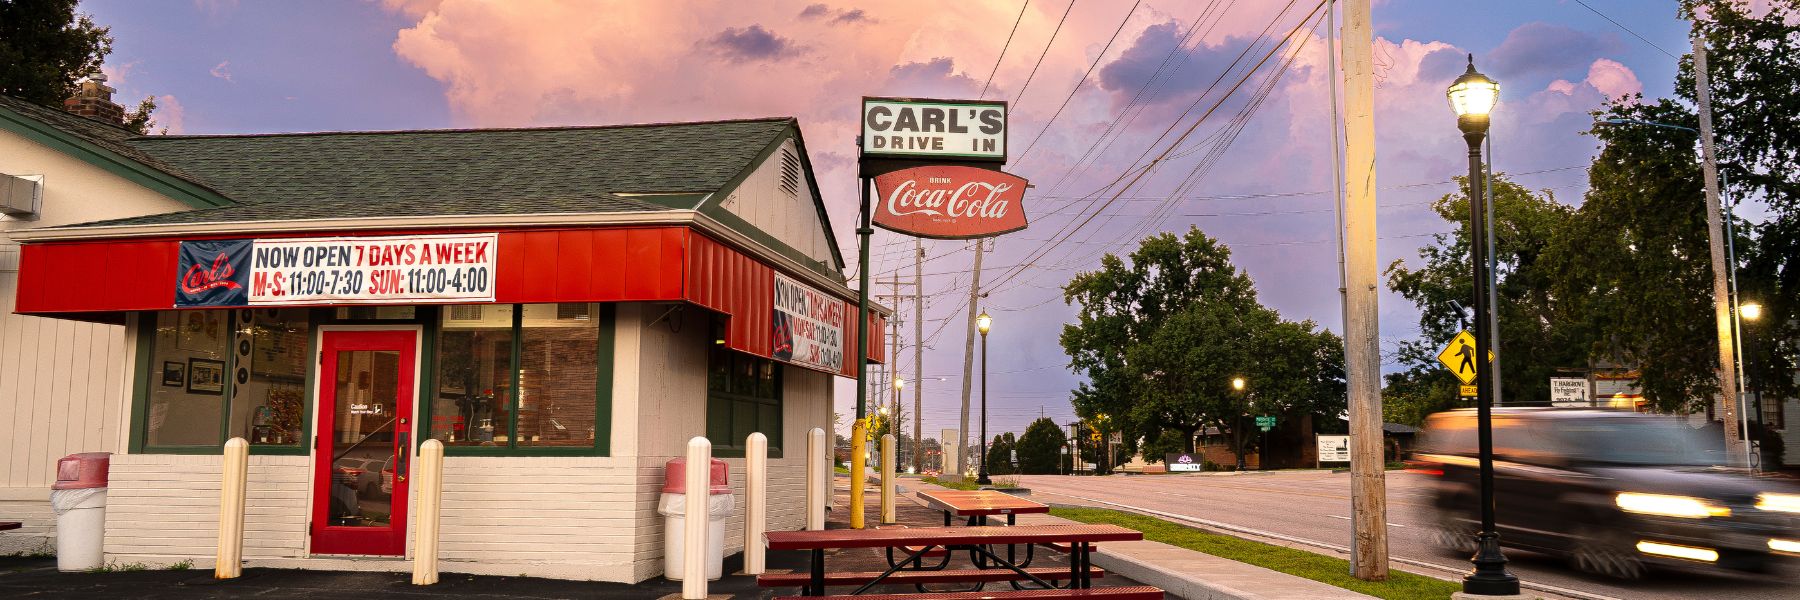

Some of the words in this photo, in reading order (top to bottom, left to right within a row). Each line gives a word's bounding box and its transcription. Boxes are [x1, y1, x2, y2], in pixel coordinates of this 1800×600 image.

[867, 106, 1003, 135] CARL'S
[873, 135, 944, 150] DRIVE
[972, 138, 996, 152] IN
[887, 179, 1014, 219] Coca-Cola
[255, 246, 300, 268] NOW
[303, 245, 352, 268] OPEN
[355, 245, 365, 266] 7
[368, 244, 416, 266] DAYS
[419, 243, 432, 265] A
[436, 242, 489, 264] WEEK
[182, 252, 238, 294] Carl's
[253, 270, 287, 297] M-S:
[289, 269, 364, 296] 11:00-7:30
[368, 268, 405, 295] SUN:
[407, 266, 488, 293] 11:00-4:00
[775, 277, 790, 310] NOW
[790, 283, 807, 317] OPEN
